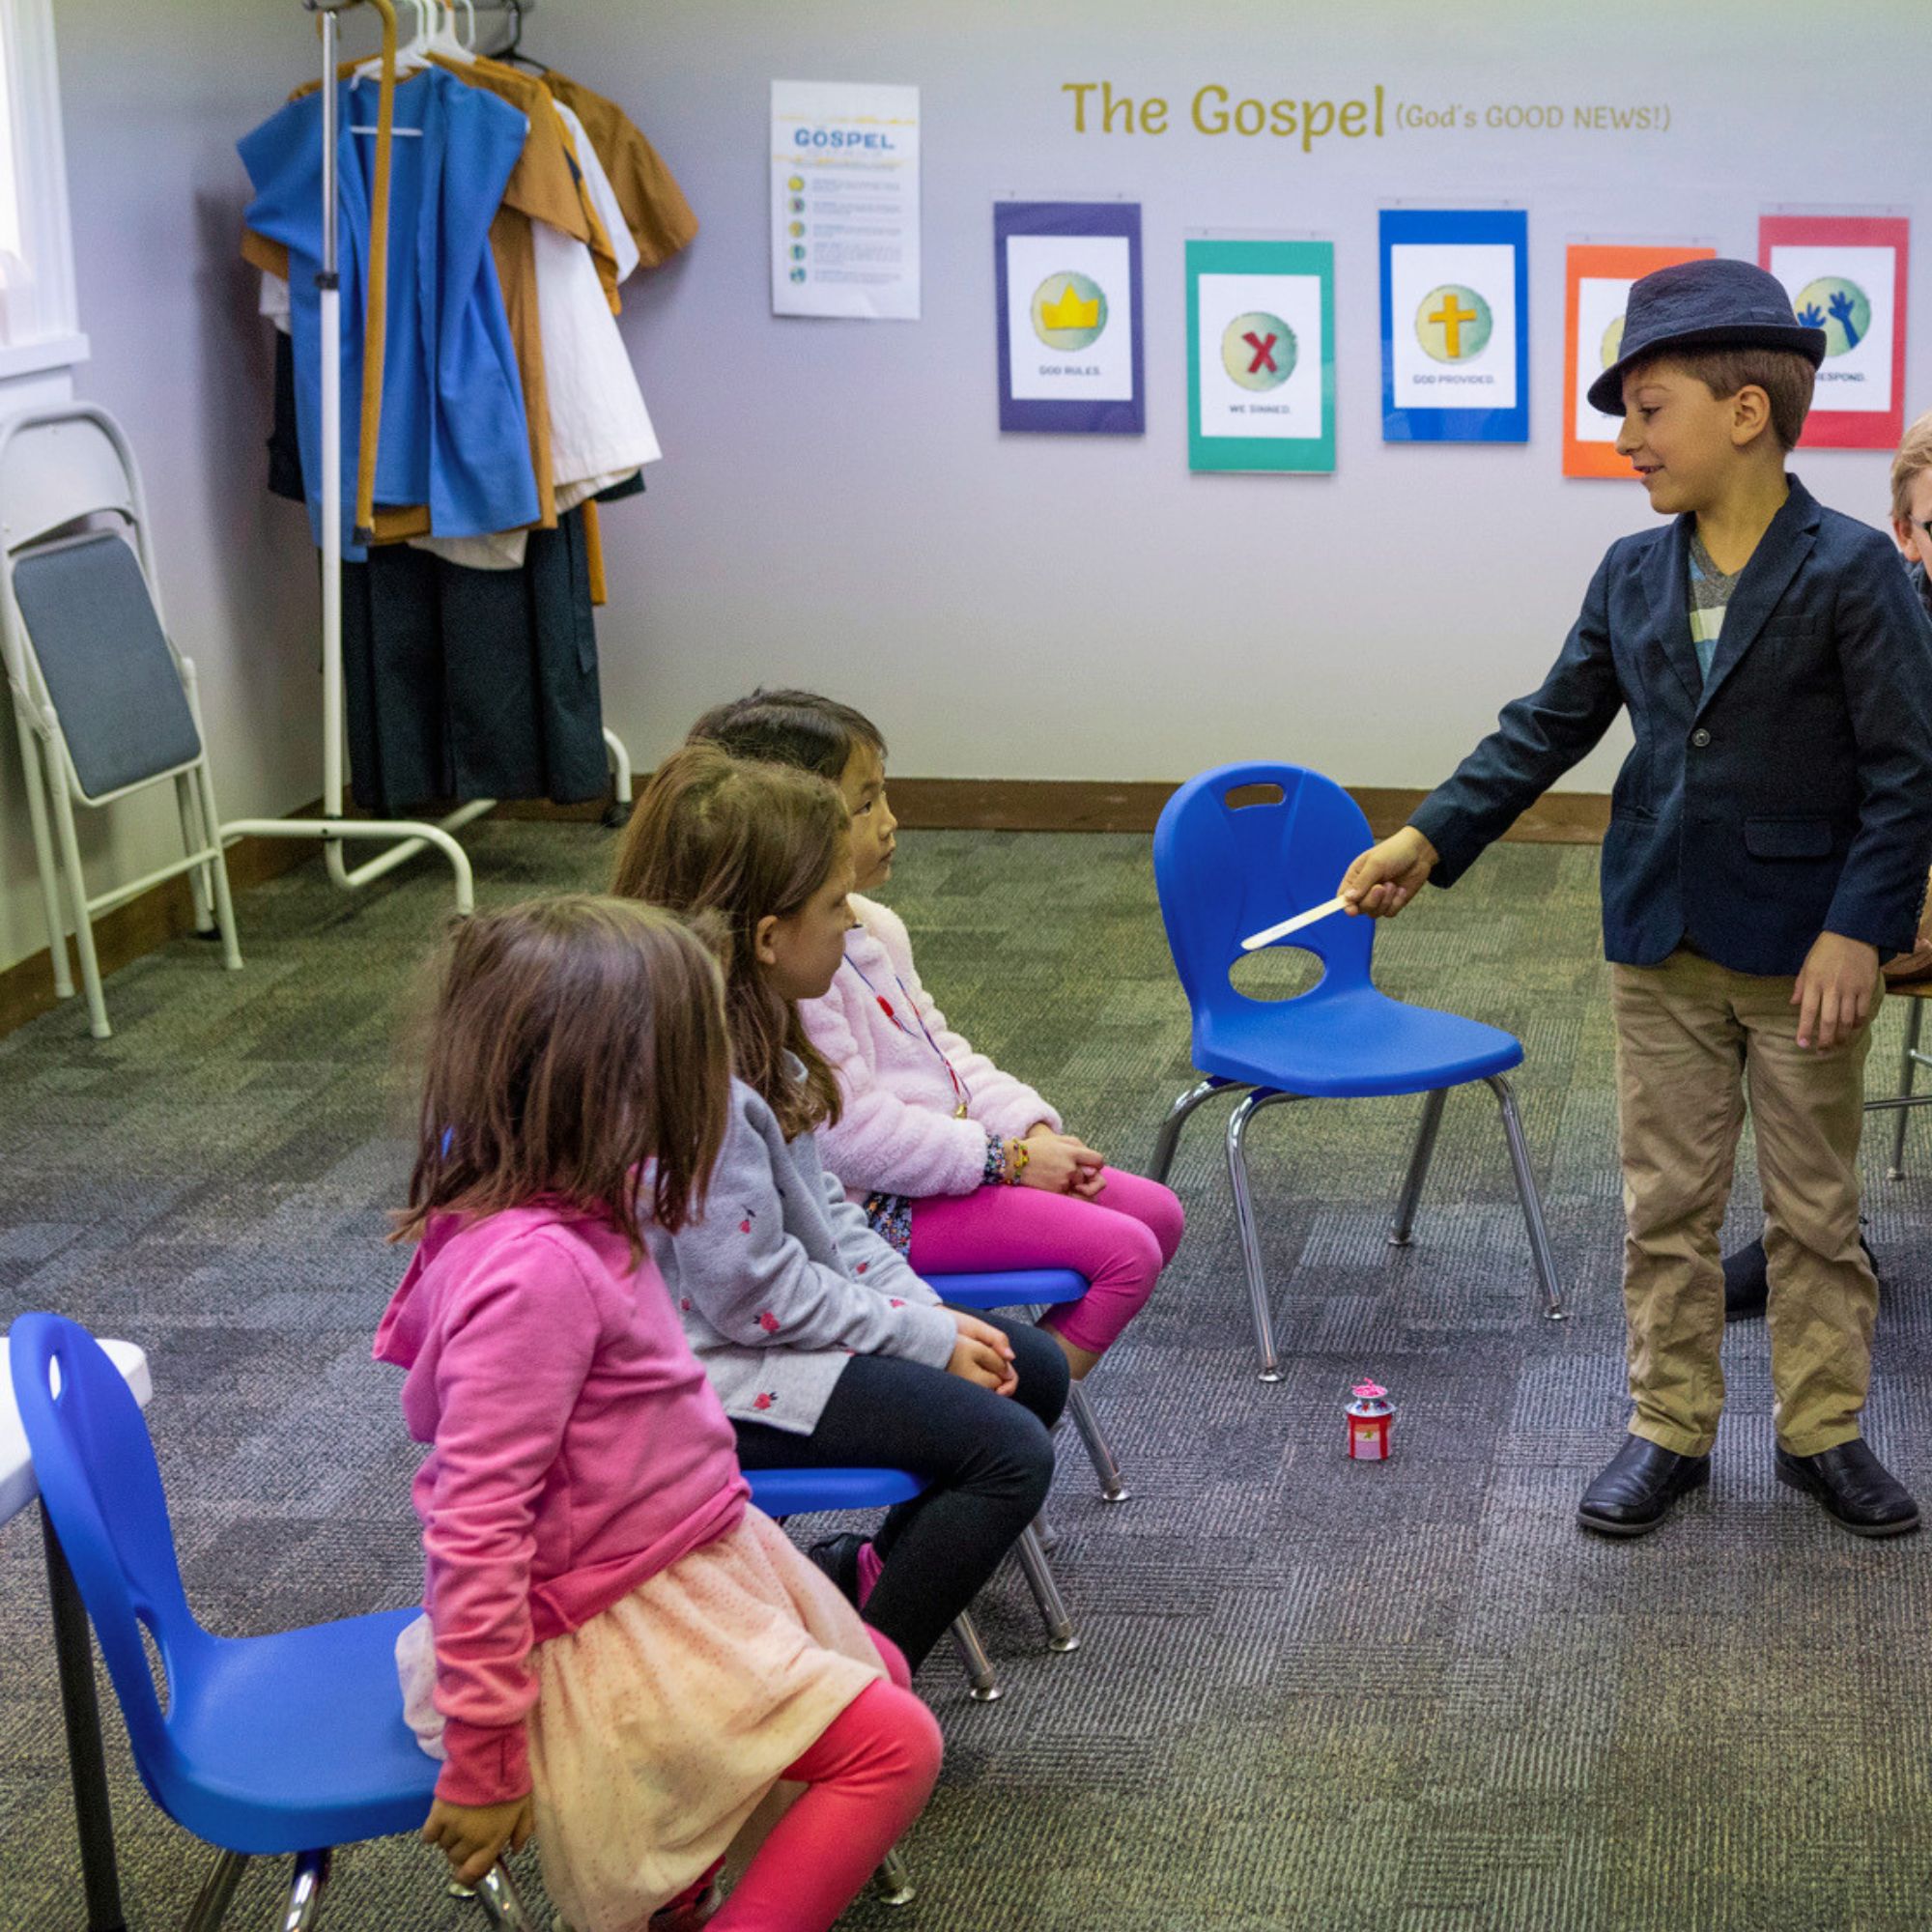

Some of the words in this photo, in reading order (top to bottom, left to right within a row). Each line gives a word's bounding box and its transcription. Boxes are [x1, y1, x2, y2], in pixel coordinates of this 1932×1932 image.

[1061, 81, 1169, 134] The
[1191, 84, 1384, 153] Gospel
[1396, 101, 1478, 129] (God's
[1486, 104, 1564, 128] GOOD
[1574, 103, 1671, 132] NEWS!)
[794, 128, 895, 150] GOSPEL
[1039, 365, 1062, 376] GOD
[1413, 374, 1436, 384] GOD
[1230, 405, 1245, 413] WE
